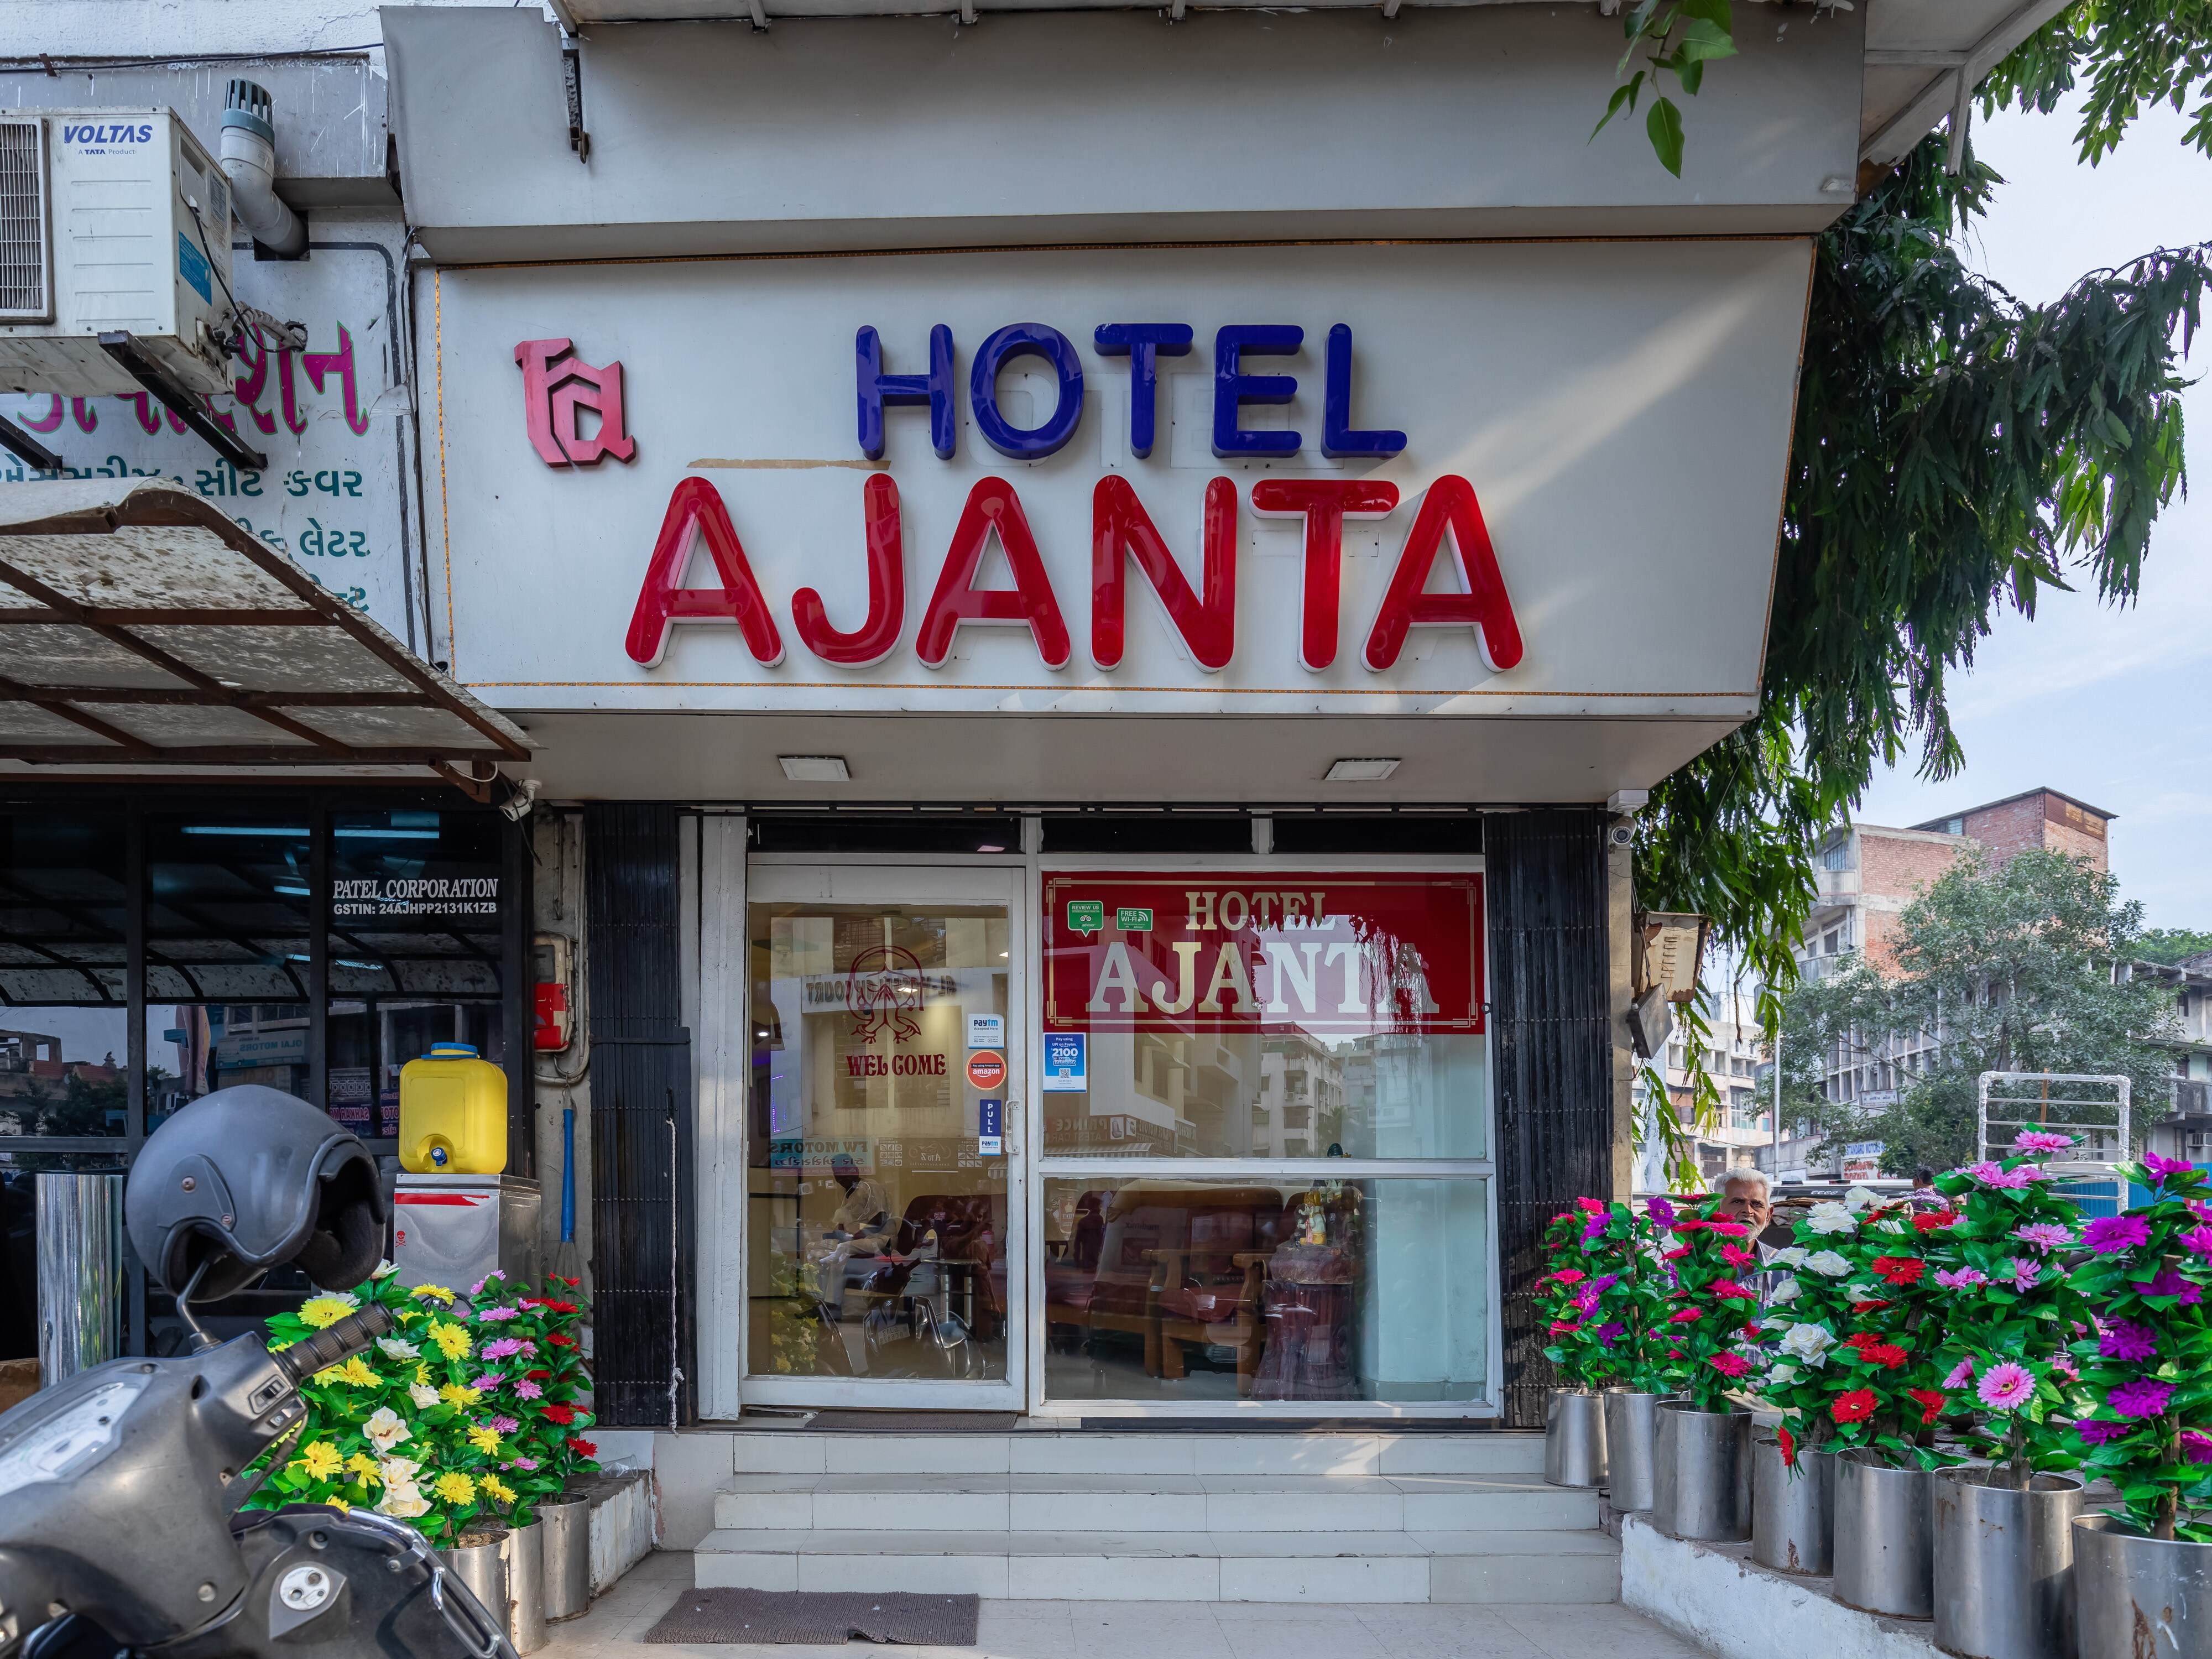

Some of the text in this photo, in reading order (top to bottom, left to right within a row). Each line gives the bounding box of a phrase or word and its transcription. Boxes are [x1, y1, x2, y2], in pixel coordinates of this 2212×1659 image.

[64, 124, 153, 144] VOLTAS
[855, 321, 1408, 461] HOTEL
[283, 469, 363, 497] કવર
[299, 517, 371, 557] લેટર
[625, 473, 1525, 674] AJANTA
[333, 878, 499, 899] PATEL CORPORATION
[333, 903, 375, 915] GSTIN:
[1186, 891, 1335, 931] HOTEL
[1086, 941, 1439, 1013] AJANTA
[973, 1018, 998, 1026] paytm
